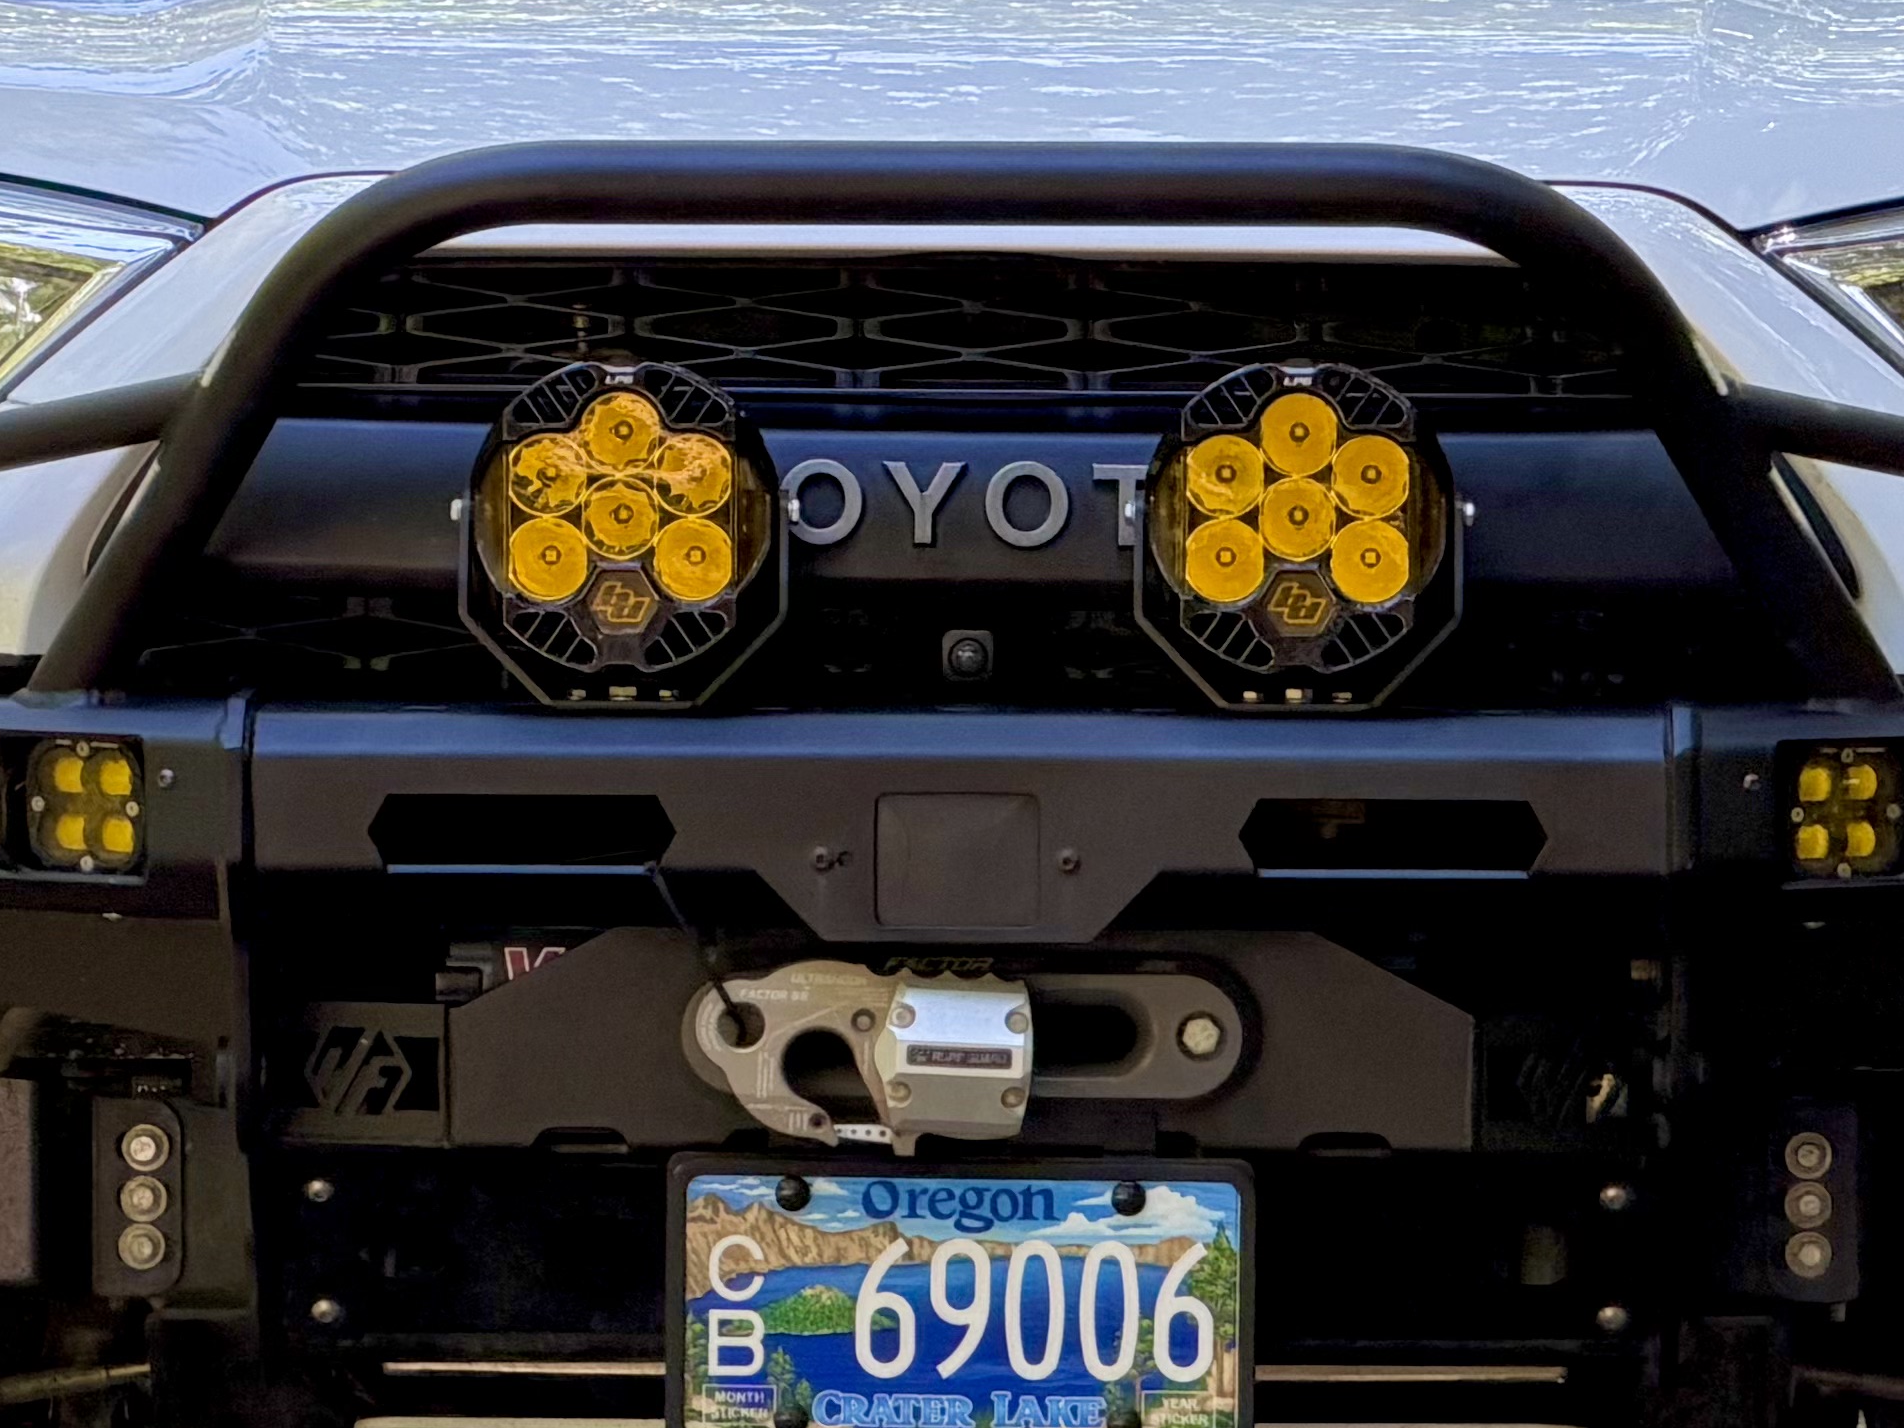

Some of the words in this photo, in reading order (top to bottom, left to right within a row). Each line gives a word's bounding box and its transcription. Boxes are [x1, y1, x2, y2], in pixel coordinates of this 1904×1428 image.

[781, 458, 1148, 547] OYOT
[739, 988, 789, 1002] FACTOR
[861, 1180, 1061, 1234] Oregon
[854, 1238, 1215, 1382] 69006
[714, 1390, 766, 1404] MONTH
[811, 1389, 976, 1428] CRATER
[1161, 1396, 1199, 1410] YEAR
[1151, 1413, 1210, 1428] STICKER
